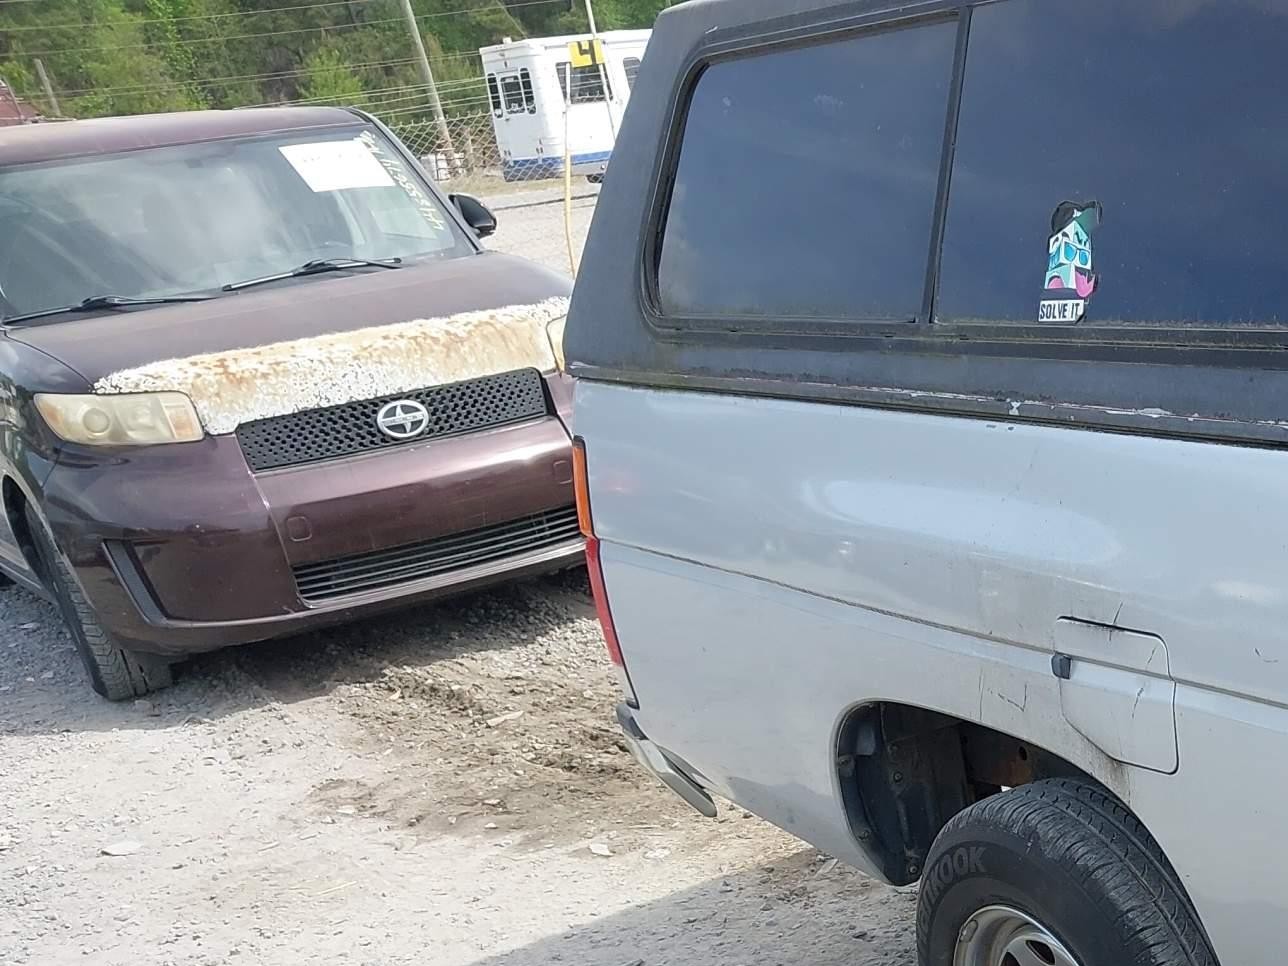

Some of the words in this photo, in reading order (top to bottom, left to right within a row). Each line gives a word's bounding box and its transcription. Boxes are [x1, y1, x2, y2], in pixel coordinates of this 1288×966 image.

[577, 40, 597, 64] 4
[1040, 303, 1068, 319] SOLVE
[1070, 302, 1081, 319] IT
